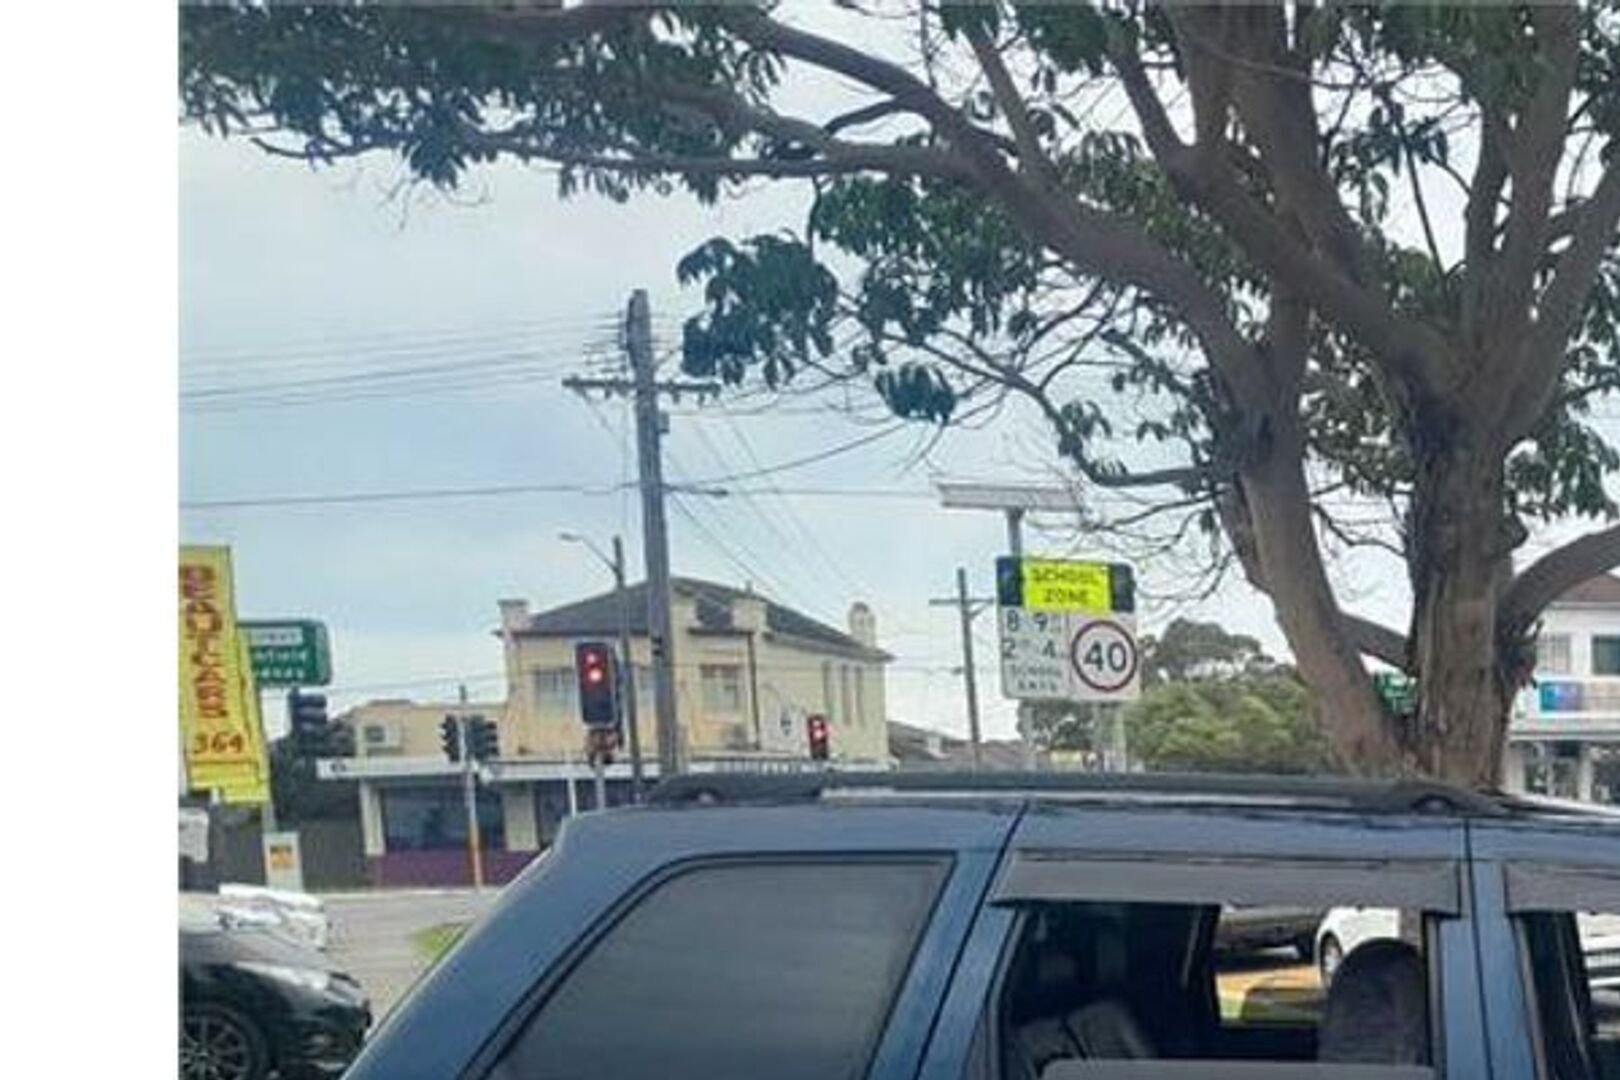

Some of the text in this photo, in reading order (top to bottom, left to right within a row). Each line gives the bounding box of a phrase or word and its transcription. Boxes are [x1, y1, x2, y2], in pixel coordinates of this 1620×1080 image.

[1031, 567, 1100, 586] SCHOOL
[1044, 587, 1089, 603] ZONE
[1083, 641, 1127, 672] 40
